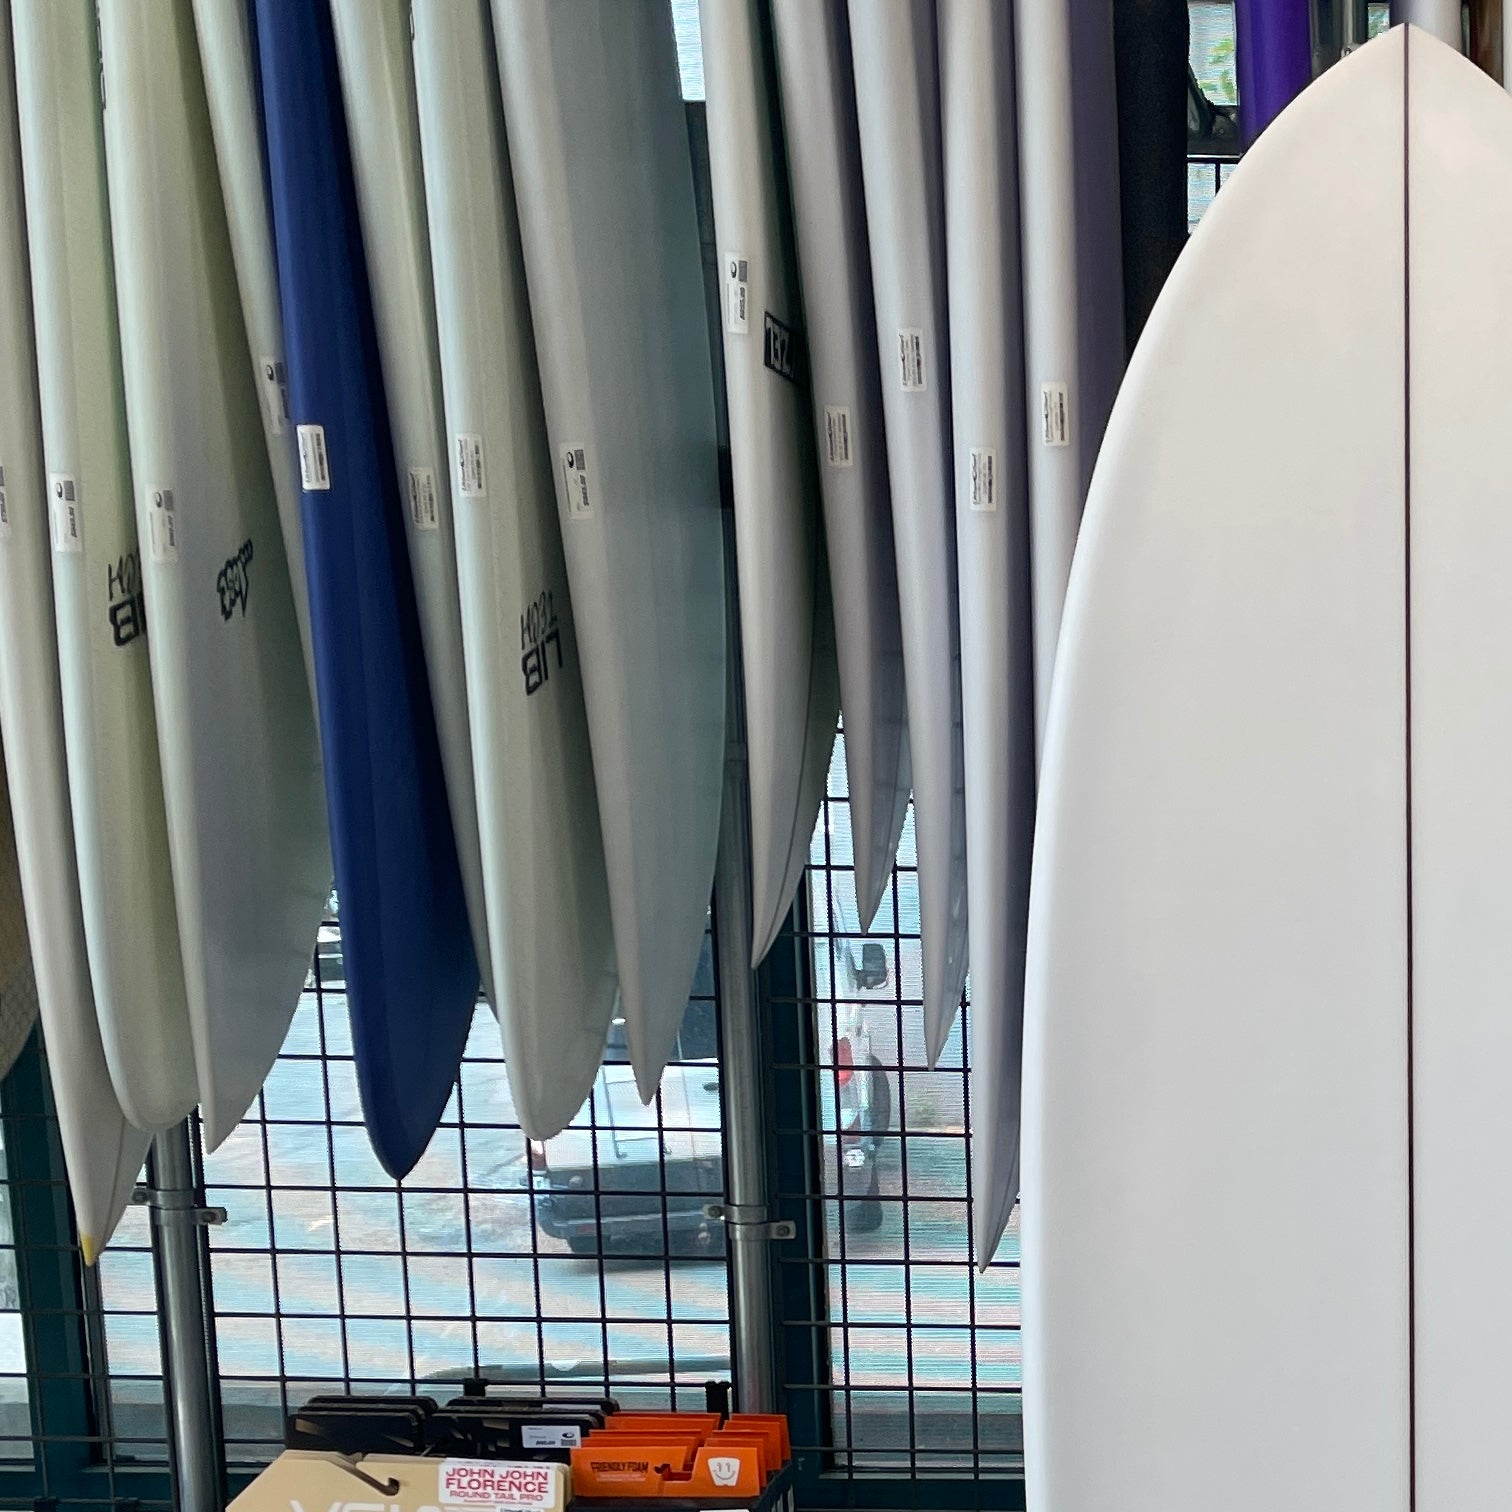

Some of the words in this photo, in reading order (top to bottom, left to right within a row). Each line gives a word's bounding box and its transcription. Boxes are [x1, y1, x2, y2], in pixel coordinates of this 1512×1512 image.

[109, 594, 147, 646] IB
[446, 1467, 495, 1479] JOHN
[500, 1470, 549, 1481] JOHN
[445, 1478, 549, 1494] FLORENCE
[449, 1490, 491, 1499] ROUND
[493, 1492, 516, 1501] TAIL
[519, 1493, 544, 1502] PRO
